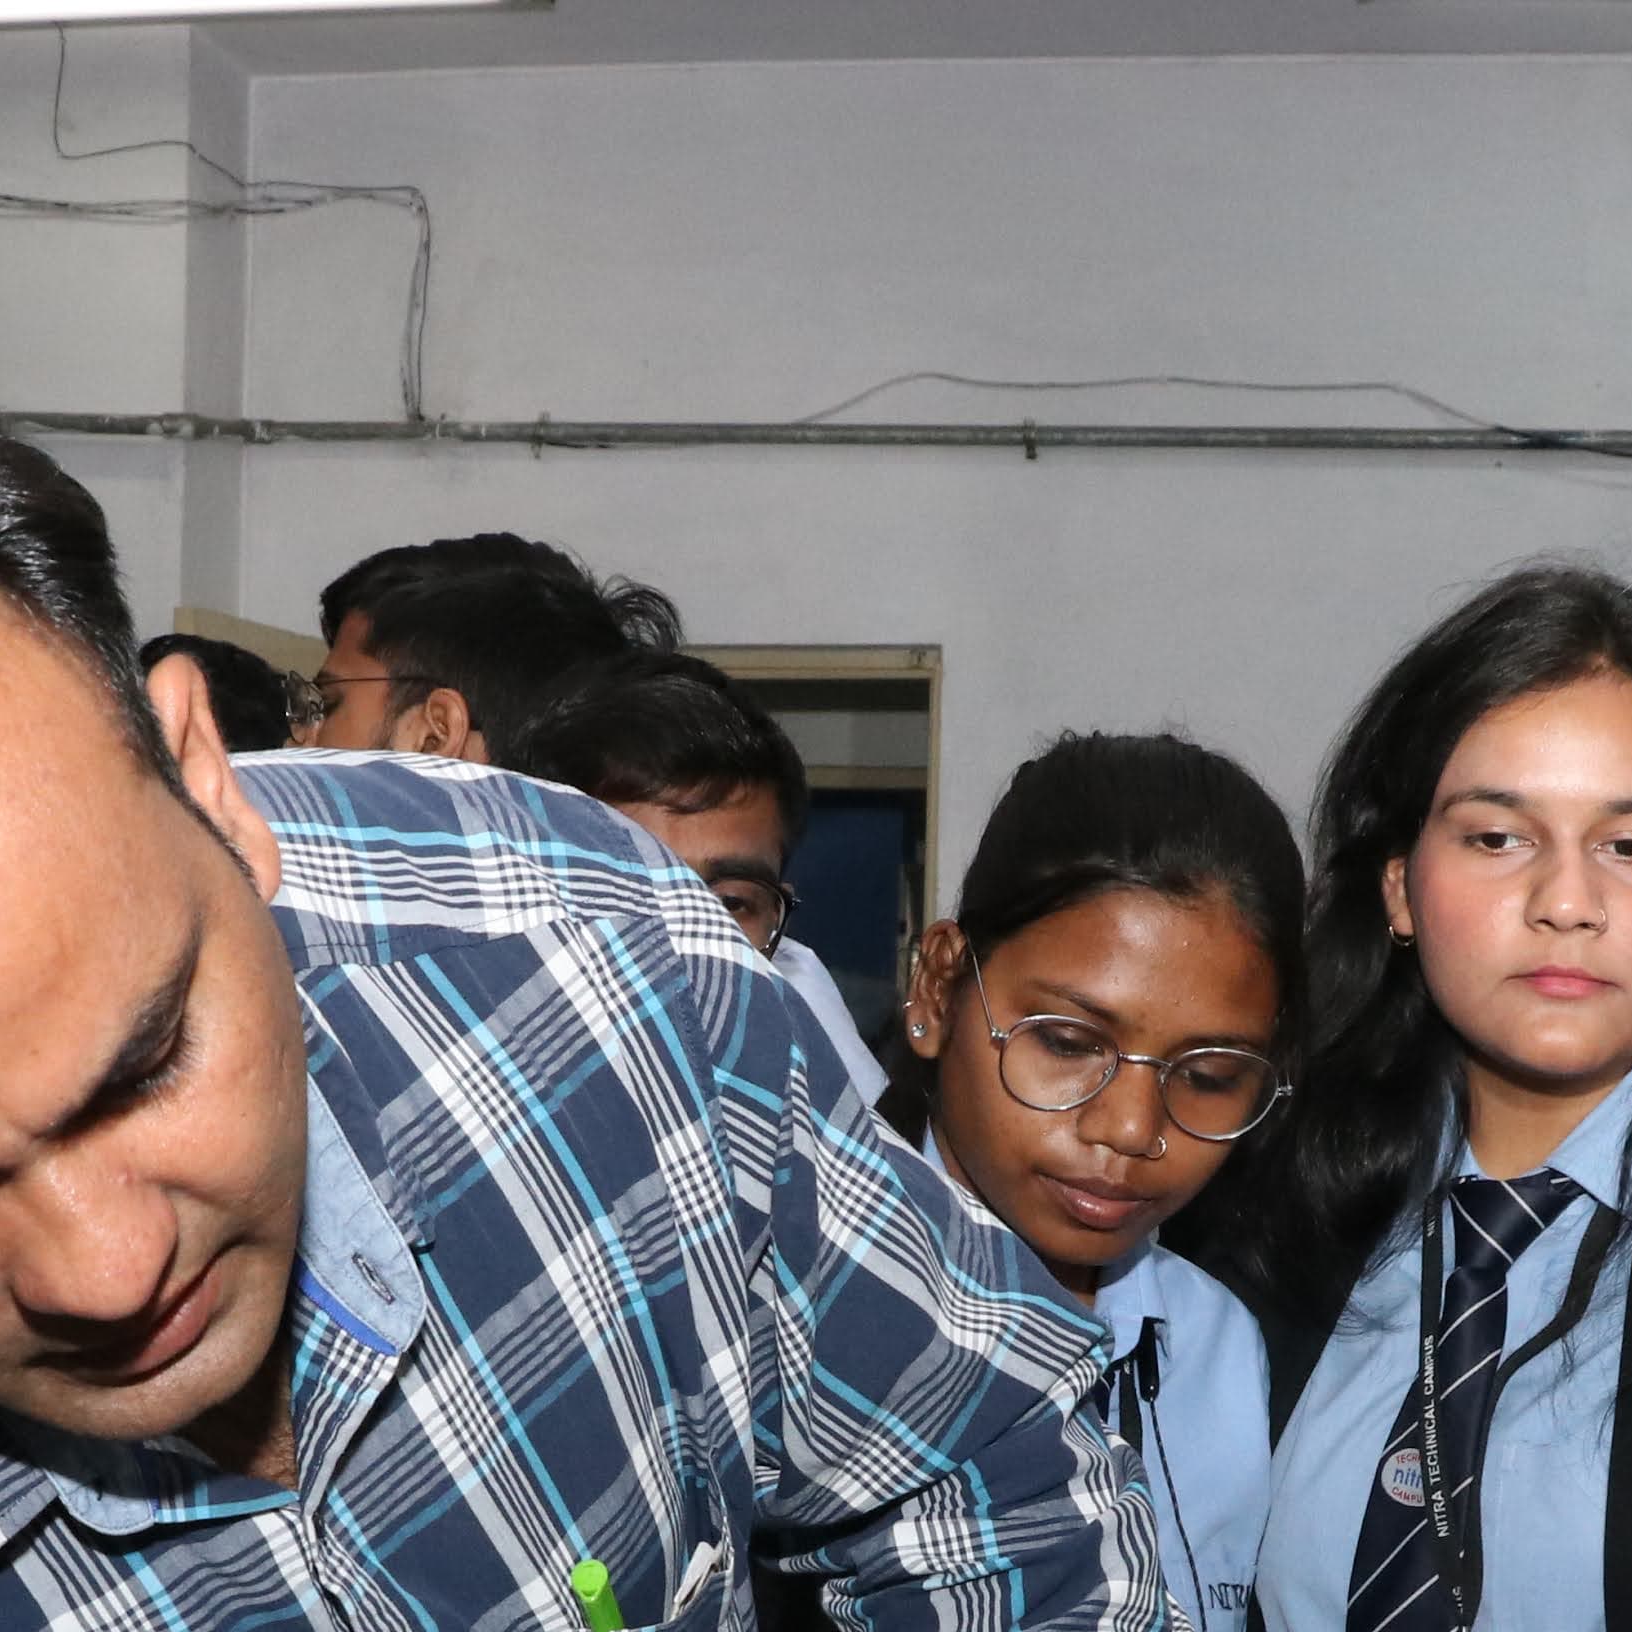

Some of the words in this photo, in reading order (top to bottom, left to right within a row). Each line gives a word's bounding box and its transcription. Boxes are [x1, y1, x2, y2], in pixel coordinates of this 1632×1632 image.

[1423, 1334, 1435, 1396] CAMPUS
[1423, 1399, 1442, 1486] TECHNICAL
[1392, 1487, 1423, 1503] CAMPU
[1431, 1490, 1450, 1538] NITRA
